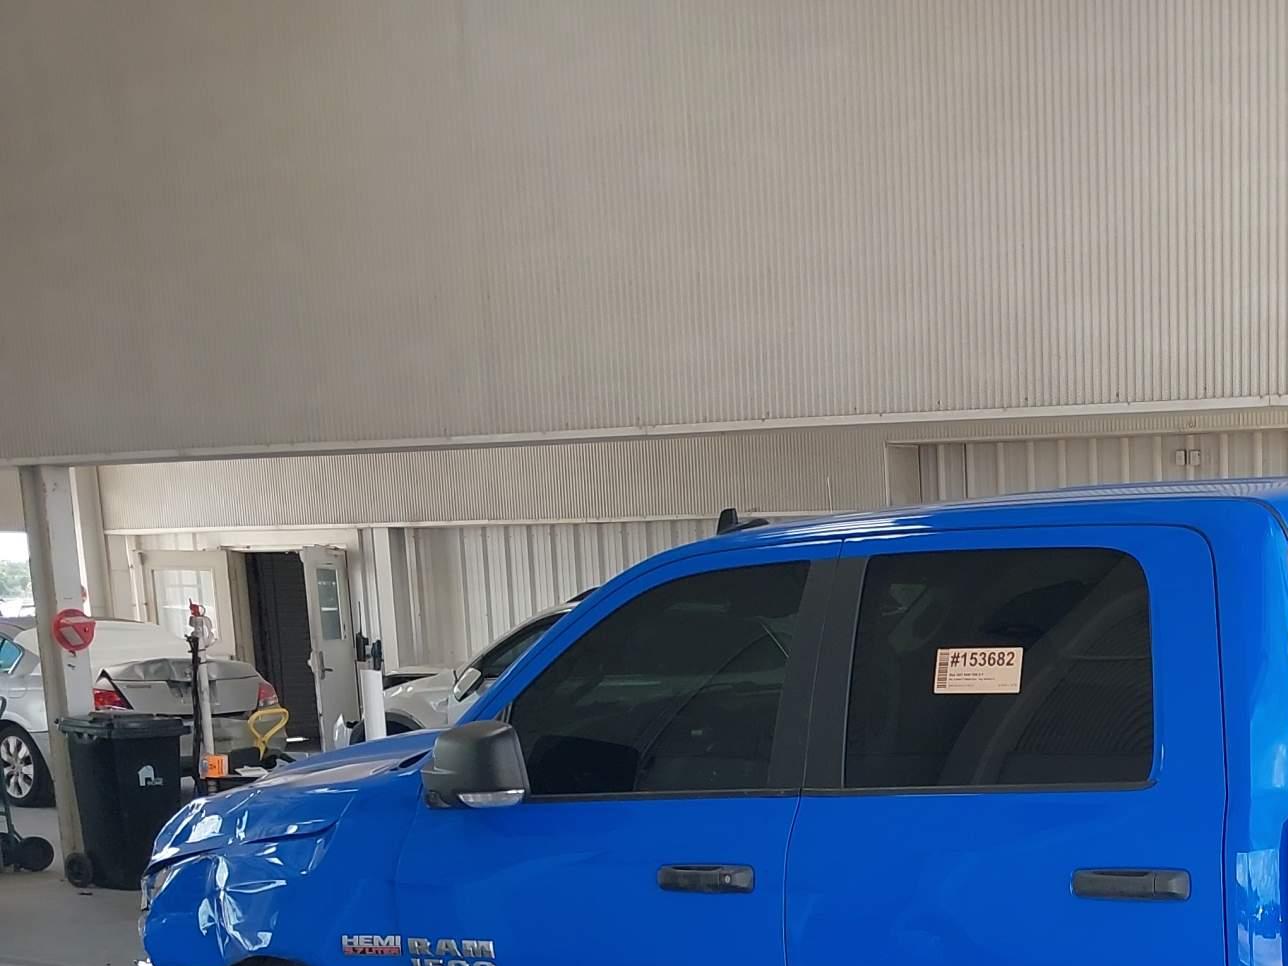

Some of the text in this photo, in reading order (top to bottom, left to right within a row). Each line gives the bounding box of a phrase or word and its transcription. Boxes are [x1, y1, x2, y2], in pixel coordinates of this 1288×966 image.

[950, 651, 1015, 667] #153682
[341, 935, 401, 946] HEMI
[407, 937, 496, 959] RAM
